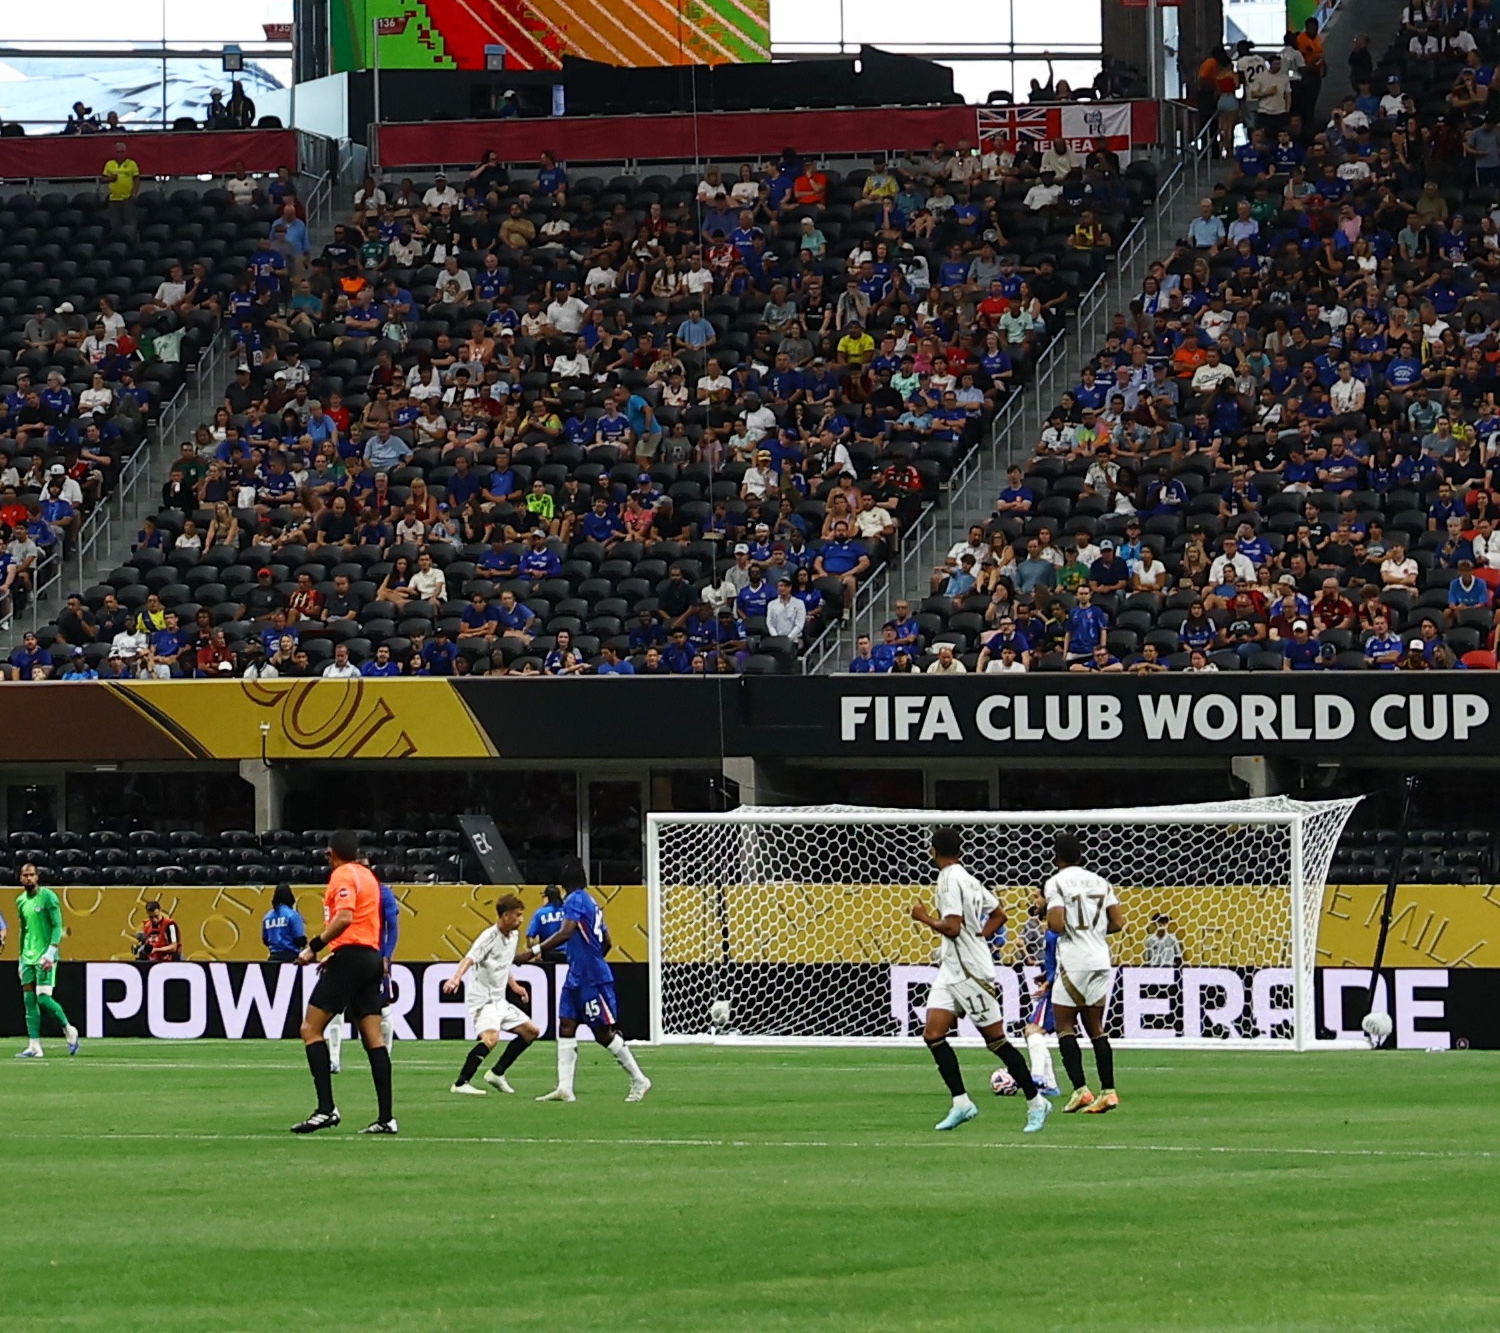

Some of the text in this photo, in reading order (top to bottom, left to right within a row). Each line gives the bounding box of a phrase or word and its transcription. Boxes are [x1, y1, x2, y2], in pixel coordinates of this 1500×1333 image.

[378, 17, 397, 30] 136
[841, 696, 963, 741] FIFA
[976, 695, 1123, 741] CLUB
[1138, 694, 1355, 741] WORLD
[1370, 694, 1489, 741] CUP
[1070, 893, 1107, 931] 17
[583, 998, 601, 1020] 45
[965, 992, 991, 1017] 11
